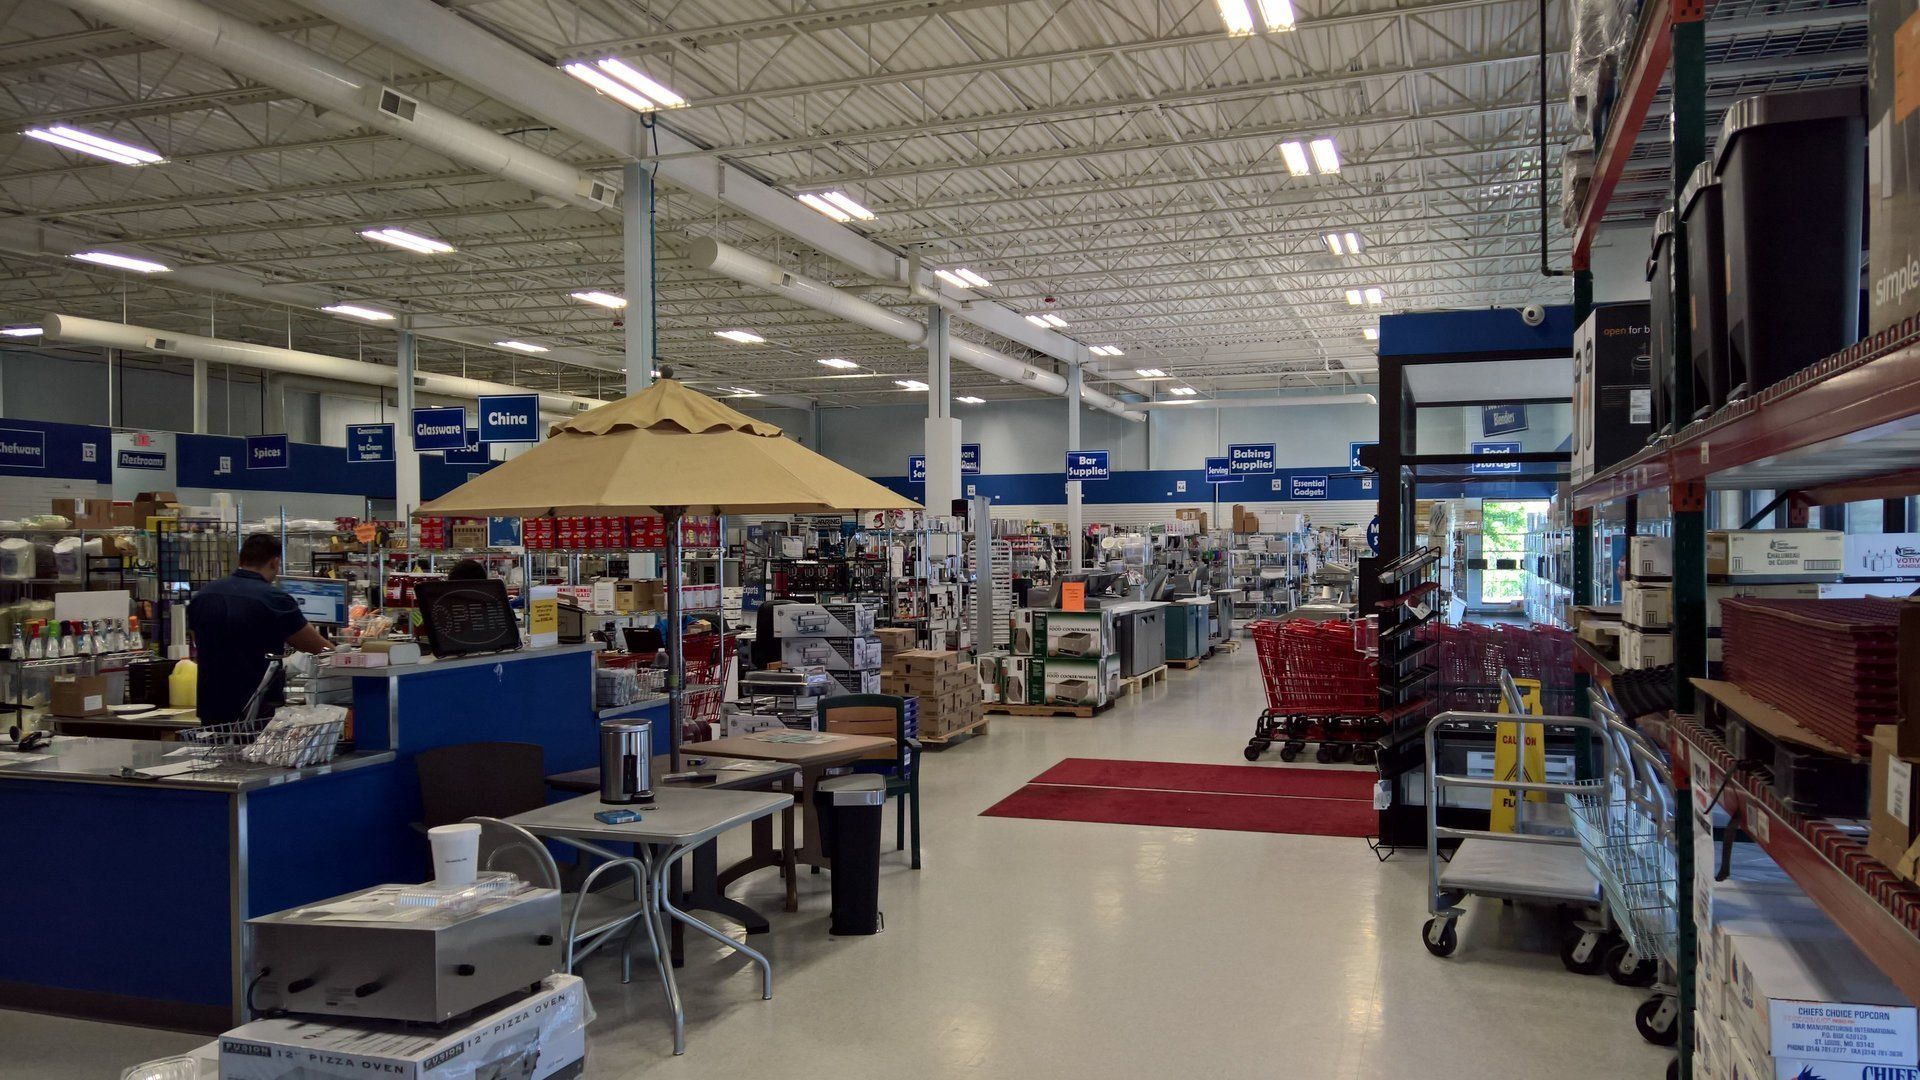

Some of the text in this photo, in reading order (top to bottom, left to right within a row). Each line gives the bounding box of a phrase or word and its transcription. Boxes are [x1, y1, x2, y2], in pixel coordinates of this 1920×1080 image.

[1604, 327, 1626, 337] open
[1629, 325, 1641, 334] for
[488, 411, 528, 426] China
[417, 424, 461, 436] Glassware
[254, 448, 281, 459] Spices
[1233, 449, 1271, 459] Baking
[121, 453, 163, 466] Restrooms
[1079, 456, 1096, 465] Bar
[1231, 460, 1273, 470] Supplies
[1069, 467, 1107, 476] Supplies
[1208, 466, 1229, 475] Serving
[1293, 479, 1325, 487] Essential
[1294, 488, 1324, 496] Gadgets
[1502, 735, 1537, 746] CAUON
[1798, 1007, 1890, 1020] CHIEFS CHOICE POPCORN
[424, 1042, 465, 1071] FUSION
[494, 1013, 530, 1035] PIZZA
[535, 993, 566, 1013] OVEN
[1806, 1024, 1853, 1032] MANUFACTURING
[1854, 1026, 1897, 1035] INTERNATIONAL
[223, 1043, 271, 1057] FUSION
[309, 1055, 355, 1067] PIZZA
[361, 1061, 405, 1074] OVEN
[1862, 1066, 1920, 1080] CHIEF
